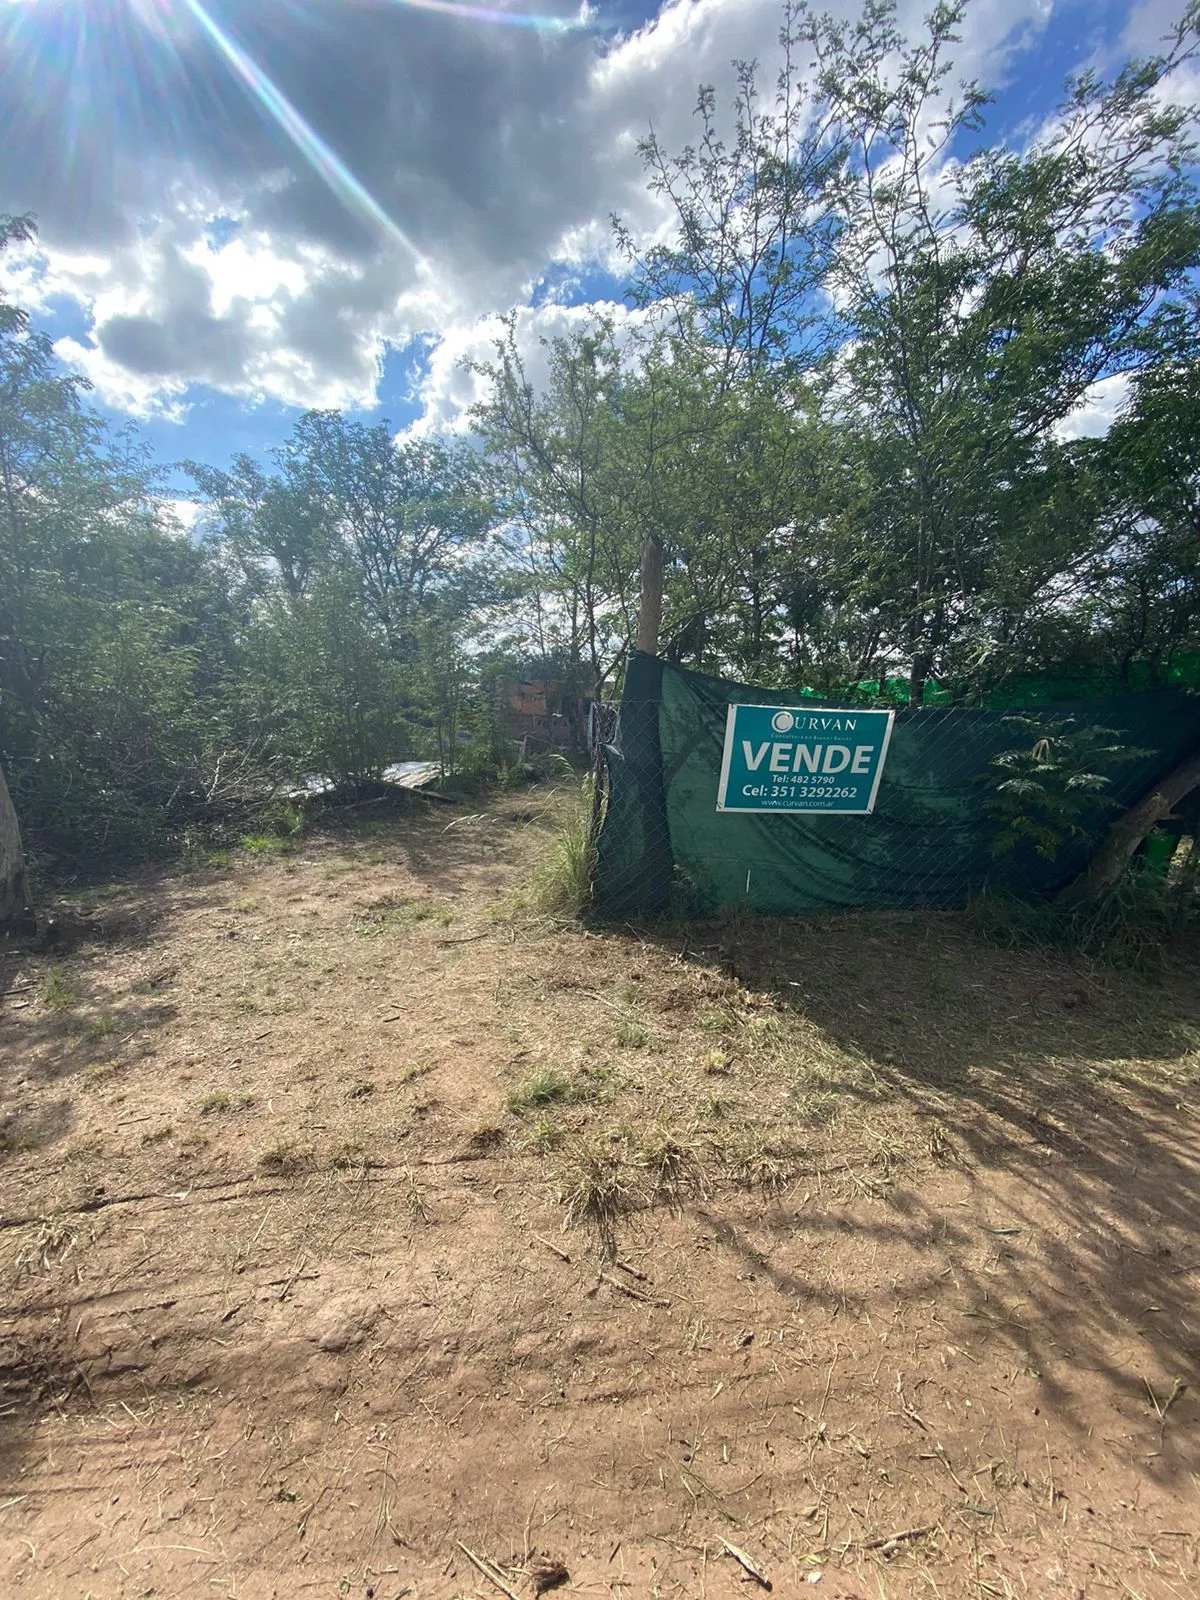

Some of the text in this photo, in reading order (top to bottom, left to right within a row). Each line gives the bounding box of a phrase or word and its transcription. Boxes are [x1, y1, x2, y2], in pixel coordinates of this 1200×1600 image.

[771, 711, 857, 733] CURVAN
[742, 740, 874, 774] VENDE
[772, 774, 835, 784] Tel: 482 5790
[742, 784, 857, 799] Cel: 351 3292262
[761, 799, 834, 808] www.curvan.com.ar
